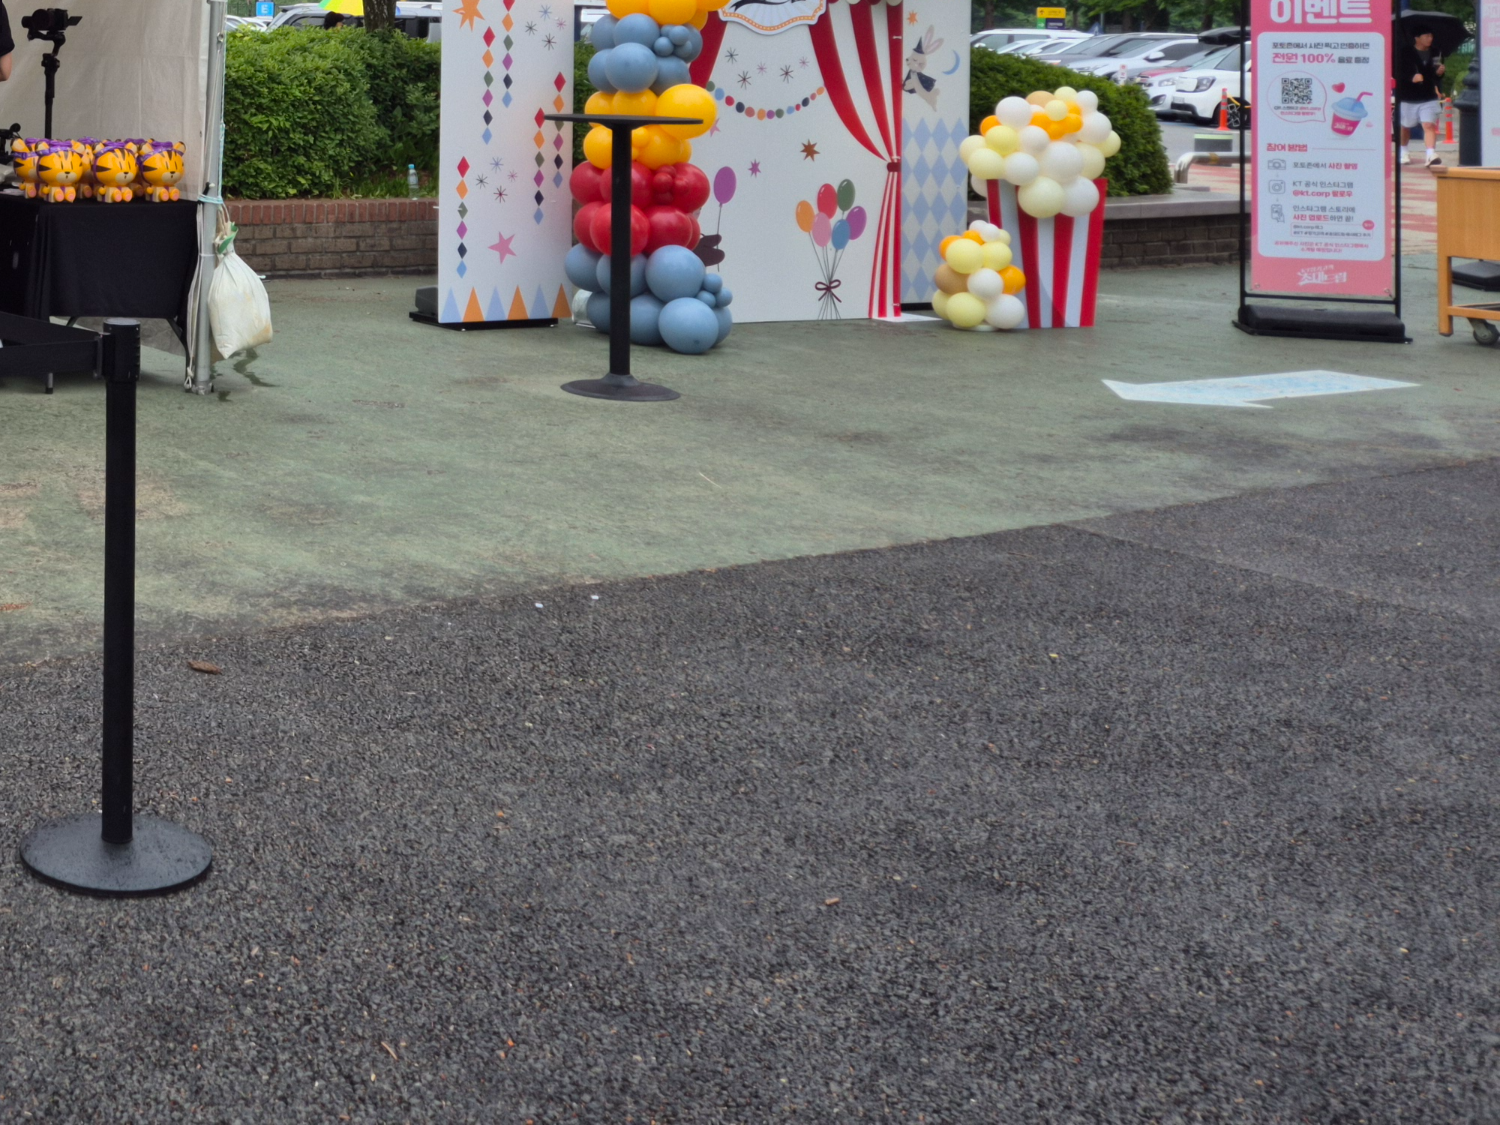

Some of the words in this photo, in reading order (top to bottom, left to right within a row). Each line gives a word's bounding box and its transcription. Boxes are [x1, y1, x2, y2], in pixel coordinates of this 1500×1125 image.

[261, 4, 269, 14] E
[1308, 42, 1324, 50] 사진
[1272, 53, 1298, 64] 전원
[1300, 53, 1336, 64] 100%
[1266, 143, 1286, 152] 참여
[1328, 162, 1342, 170] 사진
